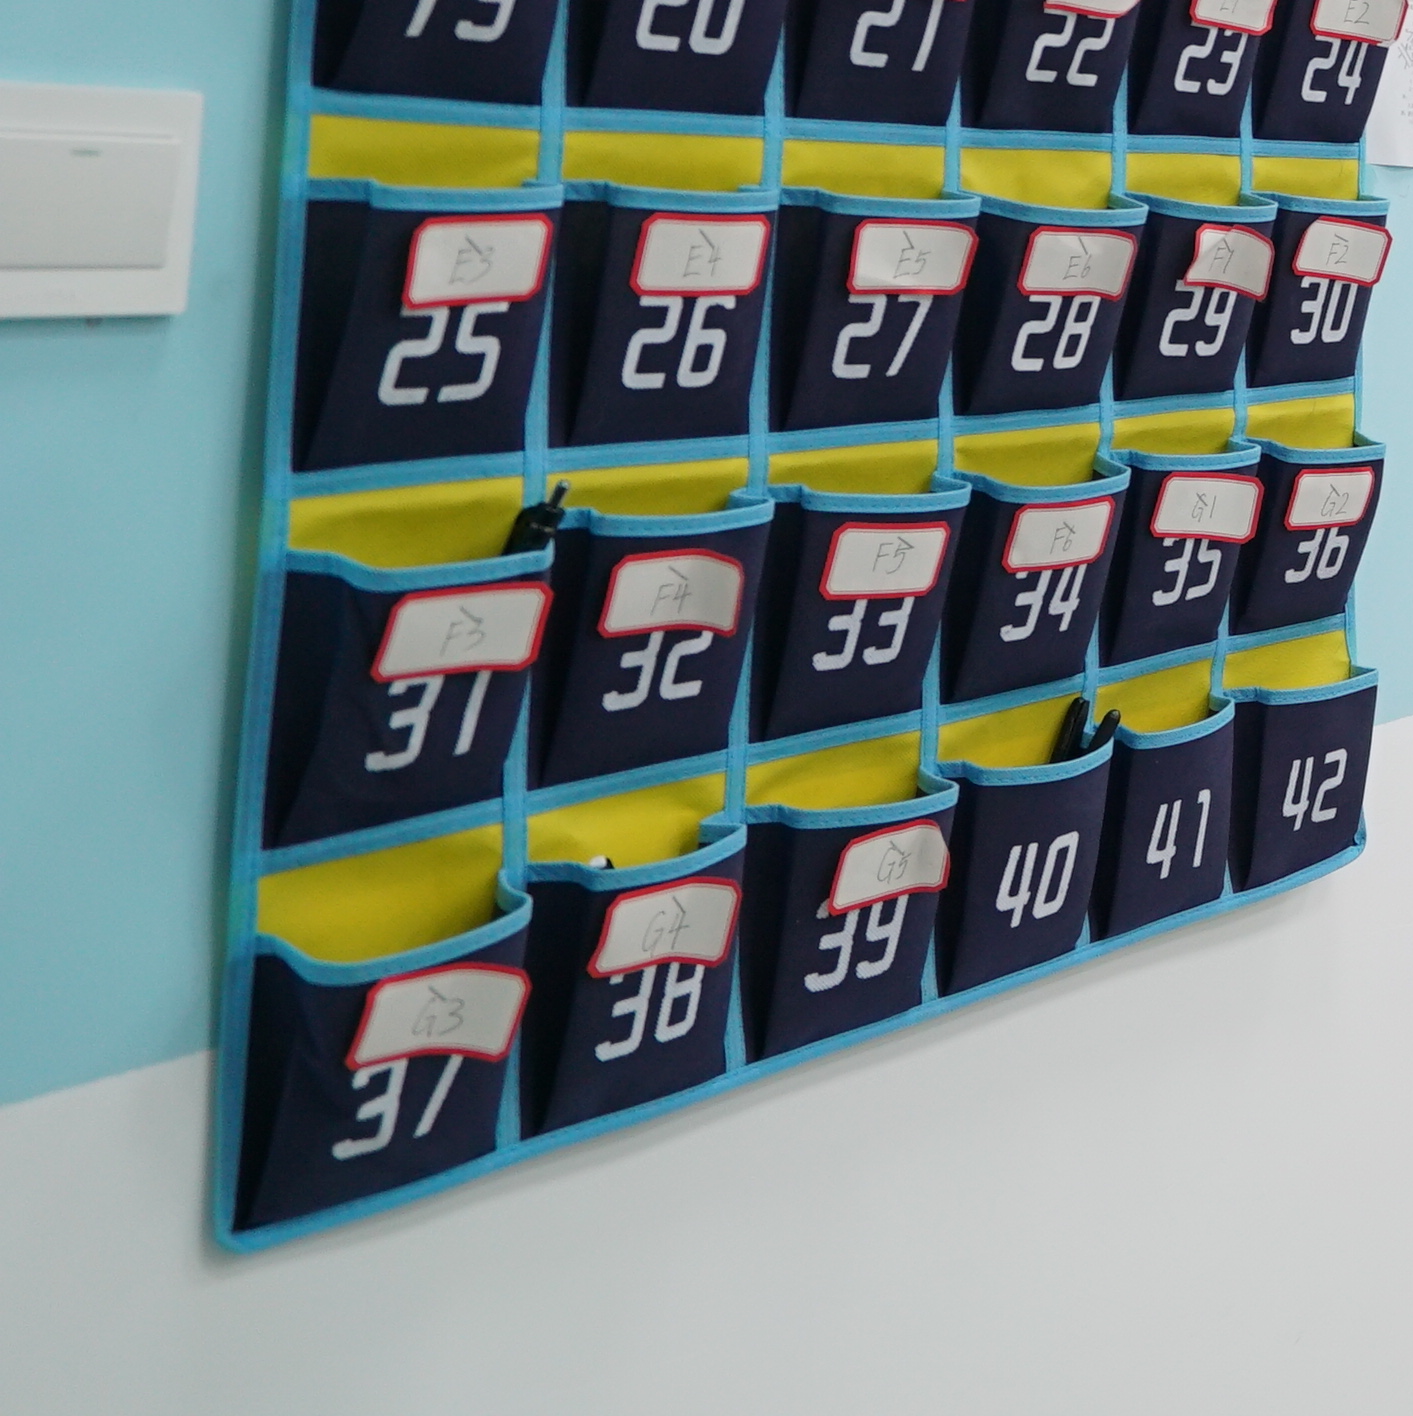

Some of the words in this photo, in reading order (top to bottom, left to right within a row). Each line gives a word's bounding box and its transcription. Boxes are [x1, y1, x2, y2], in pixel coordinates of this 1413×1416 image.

[1025, 7, 1116, 87] 22
[1173, 21, 1249, 96] 23
[1300, 35, 1369, 105] 24
[621, 295, 736, 390] 26
[831, 293, 934, 379] 27
[1011, 294, 1102, 372] 28
[1158, 279, 1238, 357] 29
[1290, 275, 1359, 345] 30
[377, 301, 510, 406] 25
[1152, 537, 1222, 607] 35
[1284, 526, 1350, 584] 36
[812, 596, 915, 672] 33
[999, 563, 1088, 642] 34
[602, 630, 714, 712] 32
[365, 670, 491, 771] 31
[1282, 748, 1348, 832] 42
[1146, 788, 1211, 880] 41
[995, 830, 1080, 929] 40
[804, 894, 909, 993] 39
[594, 962, 706, 1061] 38
[332, 1054, 463, 1159] 37
